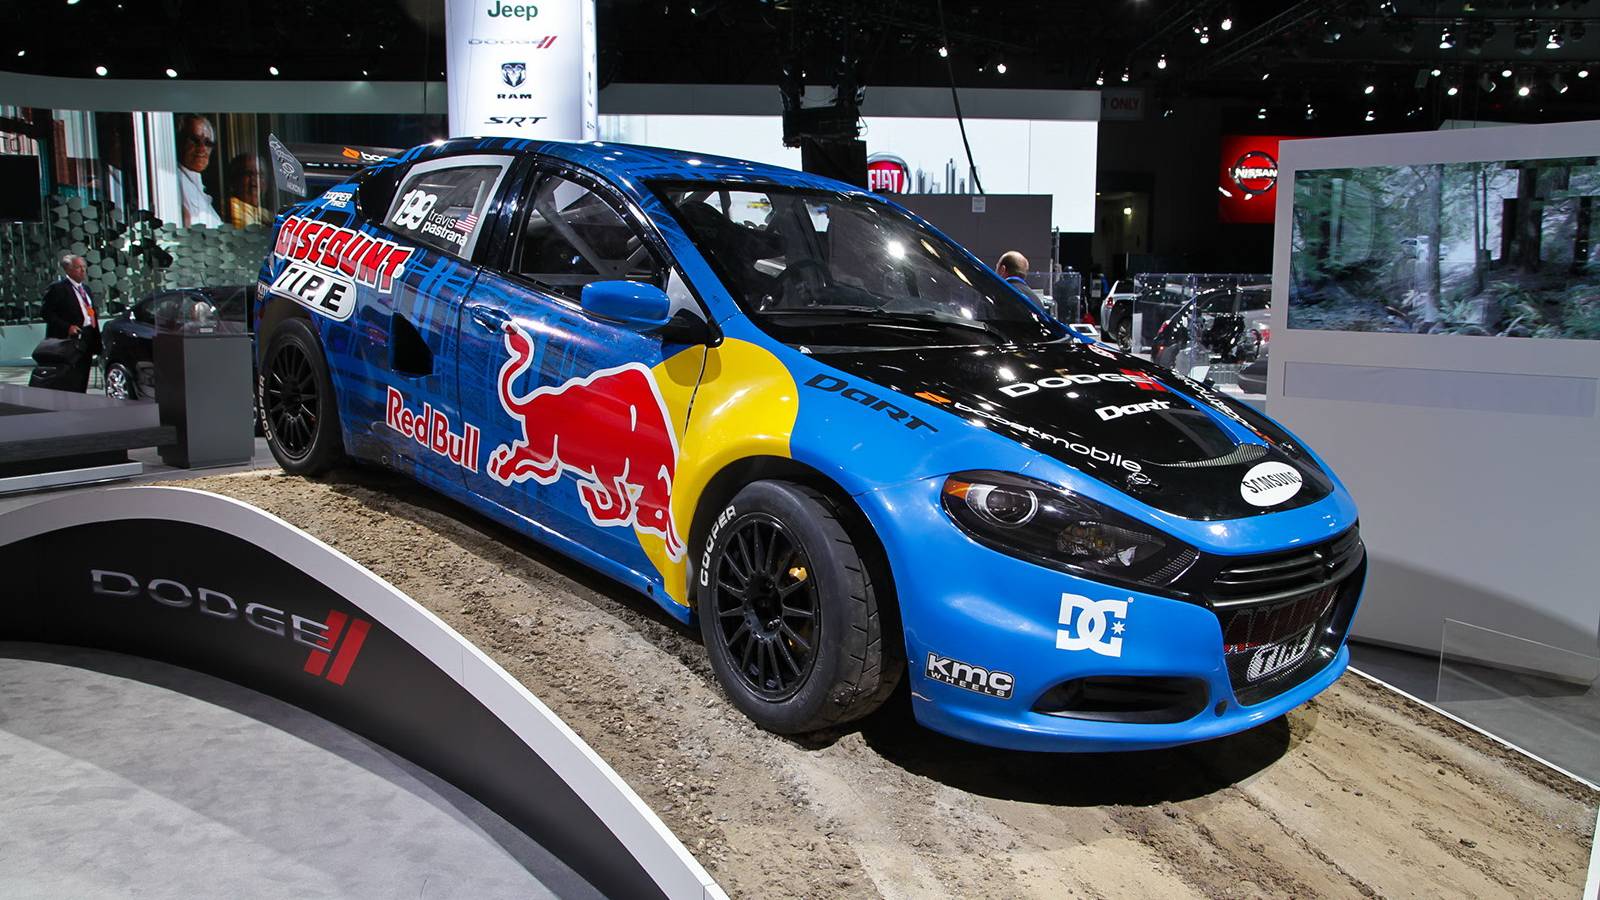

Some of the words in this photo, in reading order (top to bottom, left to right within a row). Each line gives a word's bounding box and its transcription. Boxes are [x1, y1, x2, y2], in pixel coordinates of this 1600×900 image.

[487, 0, 538, 21] Jeep
[1110, 98, 1139, 111] ONLY
[484, 116, 547, 127] SRT
[868, 169, 901, 193] FIAT
[1234, 166, 1278, 178] NISSAN
[391, 189, 438, 230] 199
[428, 209, 456, 229] travis
[420, 221, 468, 247] pastrana
[274, 216, 414, 293] DISCOUNT
[999, 373, 1154, 398] DODGE
[258, 375, 273, 441] COOPER
[954, 401, 1142, 473] boostmobile
[1242, 471, 1302, 494] SAMSUNG
[700, 504, 737, 586] COOPER
[91, 569, 331, 653] DODGE
[1056, 592, 1128, 658] DC
[930, 671, 1006, 697] WHEELS
